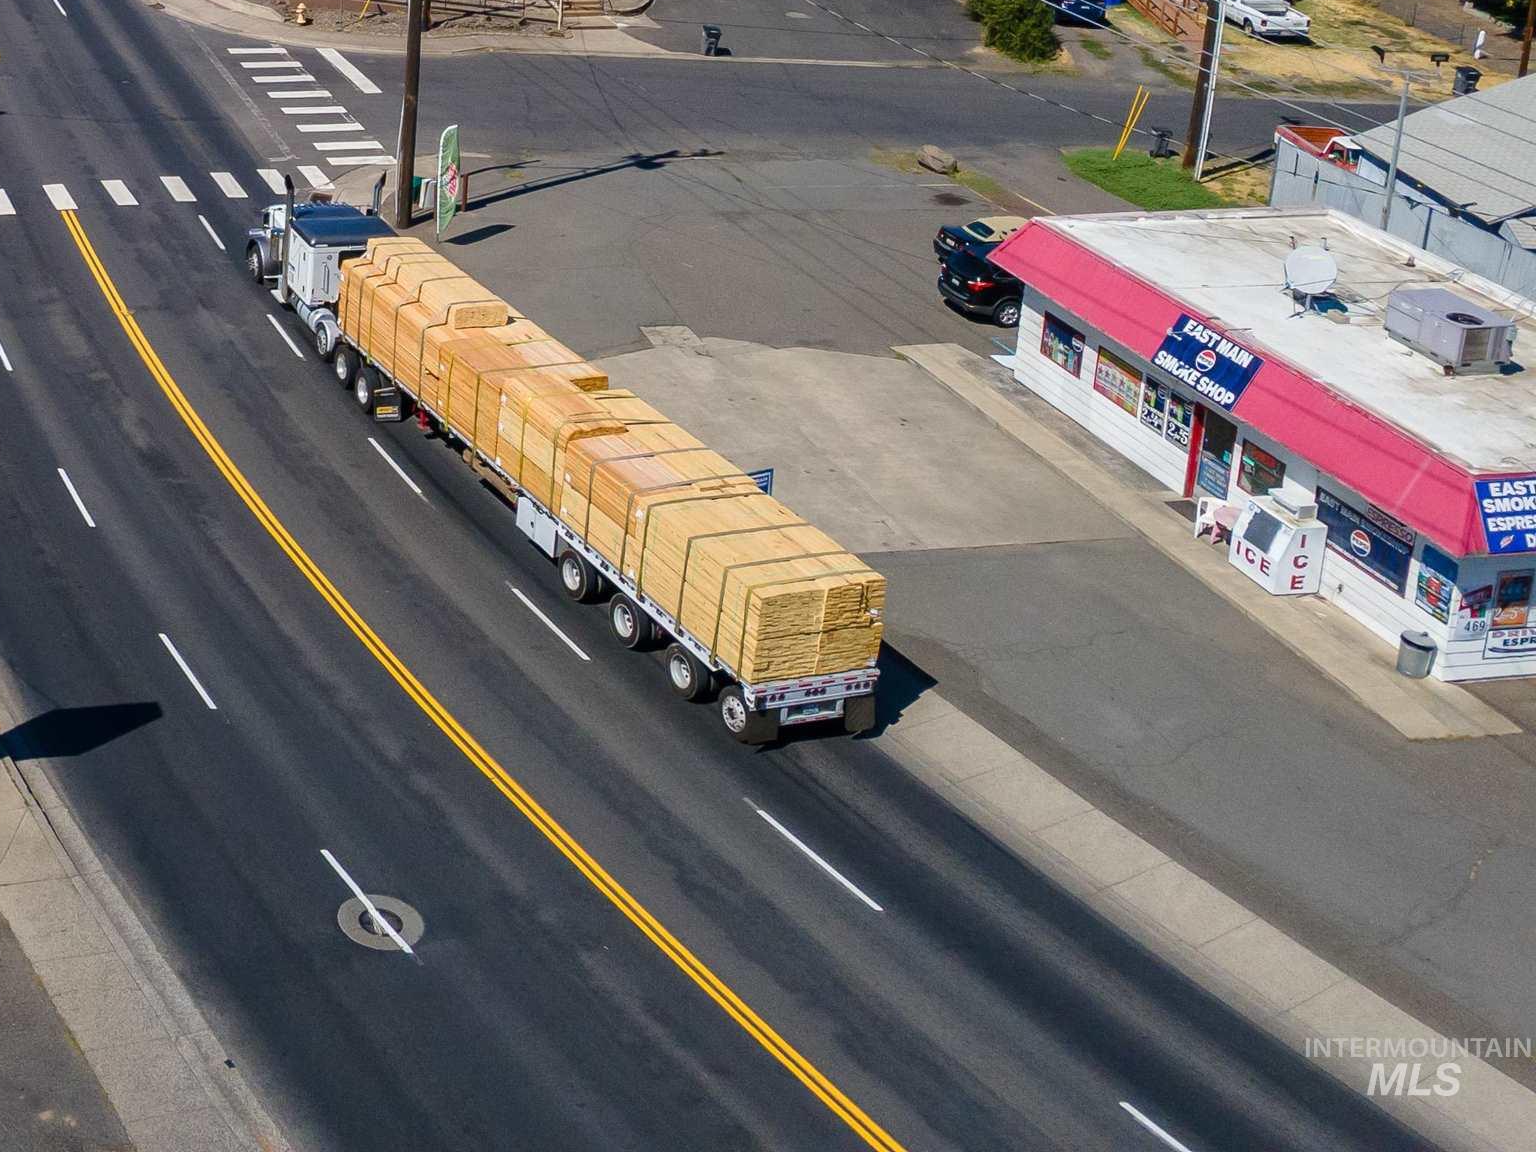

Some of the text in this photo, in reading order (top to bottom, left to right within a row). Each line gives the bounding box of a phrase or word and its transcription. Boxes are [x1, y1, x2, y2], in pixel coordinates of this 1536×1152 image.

[1183, 319, 1255, 369] EAST MAIN
[1154, 350, 1235, 405] SMOKE SHOP
[1489, 480, 1536, 497] EAST
[1236, 540, 1272, 577] ICE
[1290, 533, 1309, 590] ICE
[1463, 620, 1487, 634] 469
